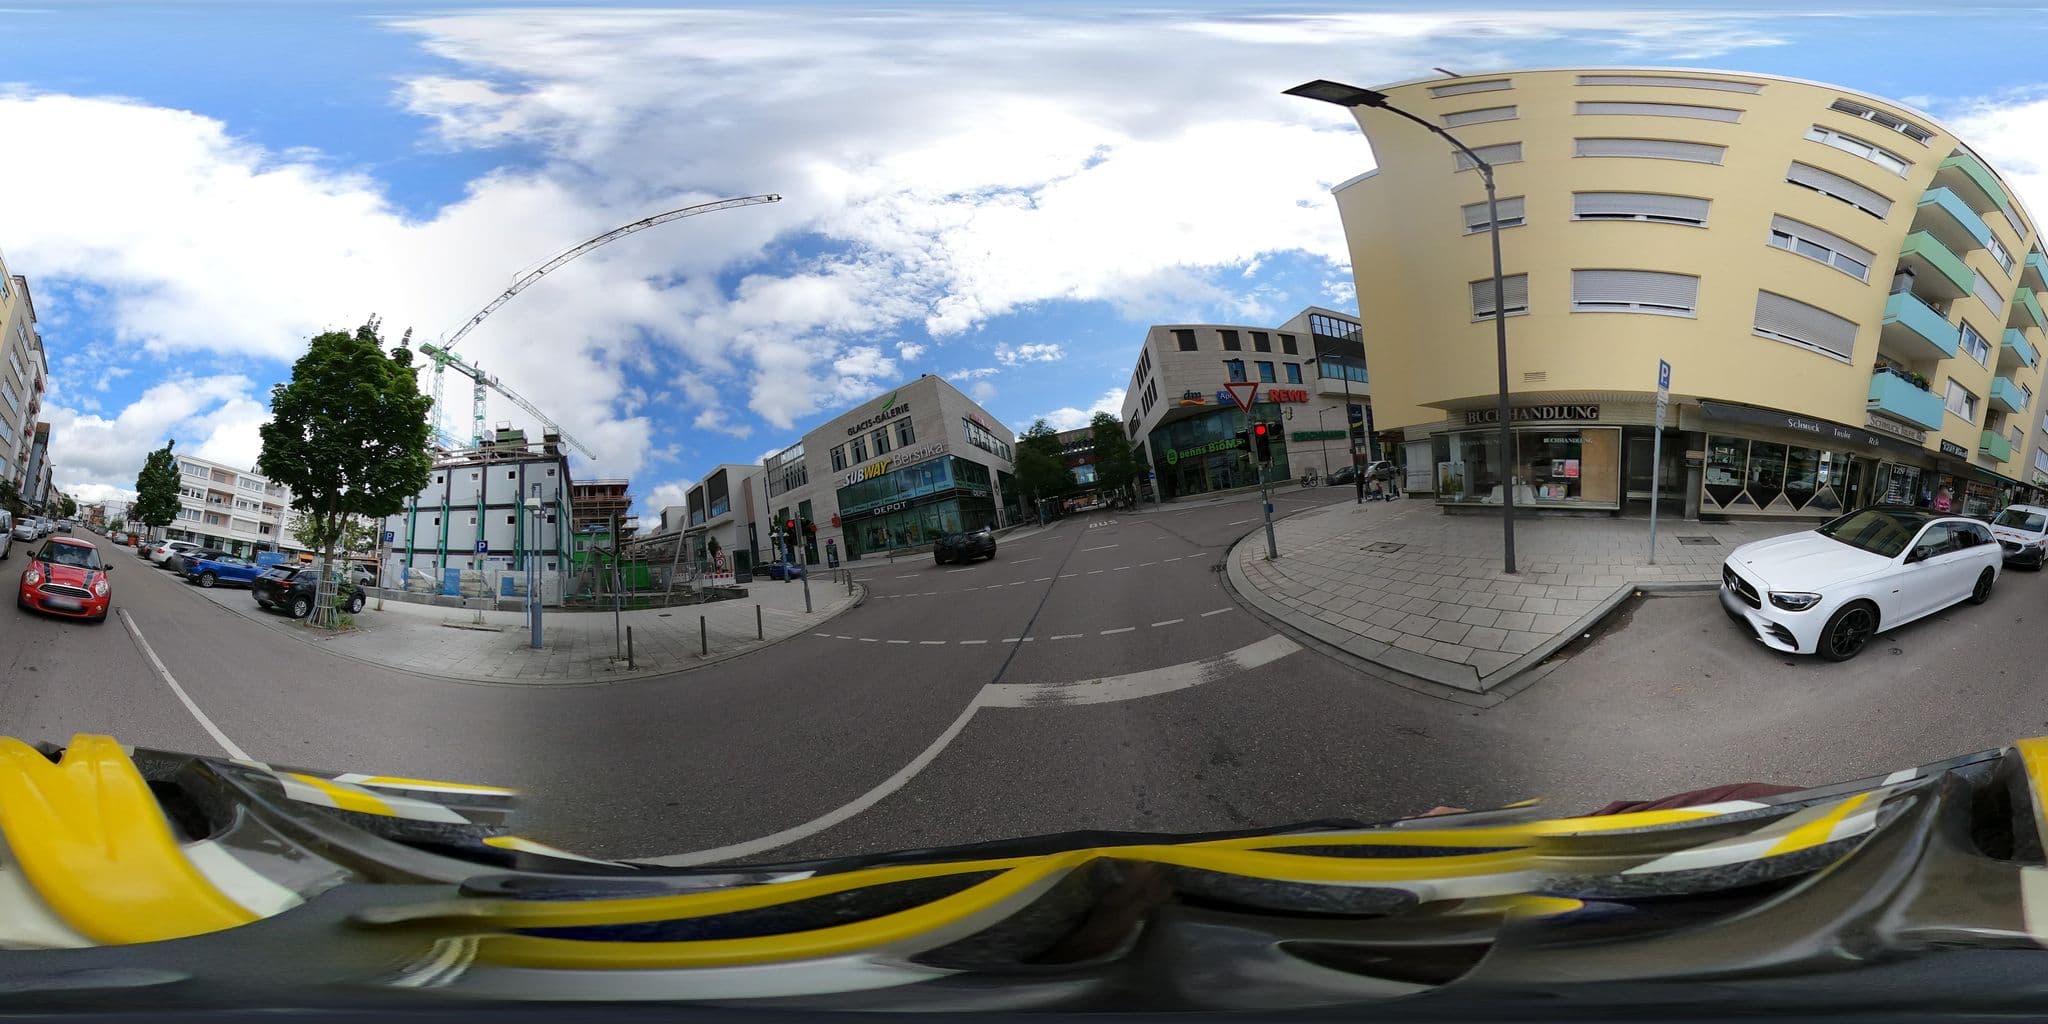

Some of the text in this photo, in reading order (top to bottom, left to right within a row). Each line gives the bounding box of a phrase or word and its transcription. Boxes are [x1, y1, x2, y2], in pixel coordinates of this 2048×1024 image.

[1184, 390, 1202, 401] dm
[1269, 390, 1309, 403] REWE
[847, 403, 910, 436] GLACIS-GALERIE
[1788, 418, 1820, 433] Schmuck
[893, 441, 945, 467] Bershka
[842, 458, 892, 487] SUBWAY
[874, 501, 908, 516] DEPOT
